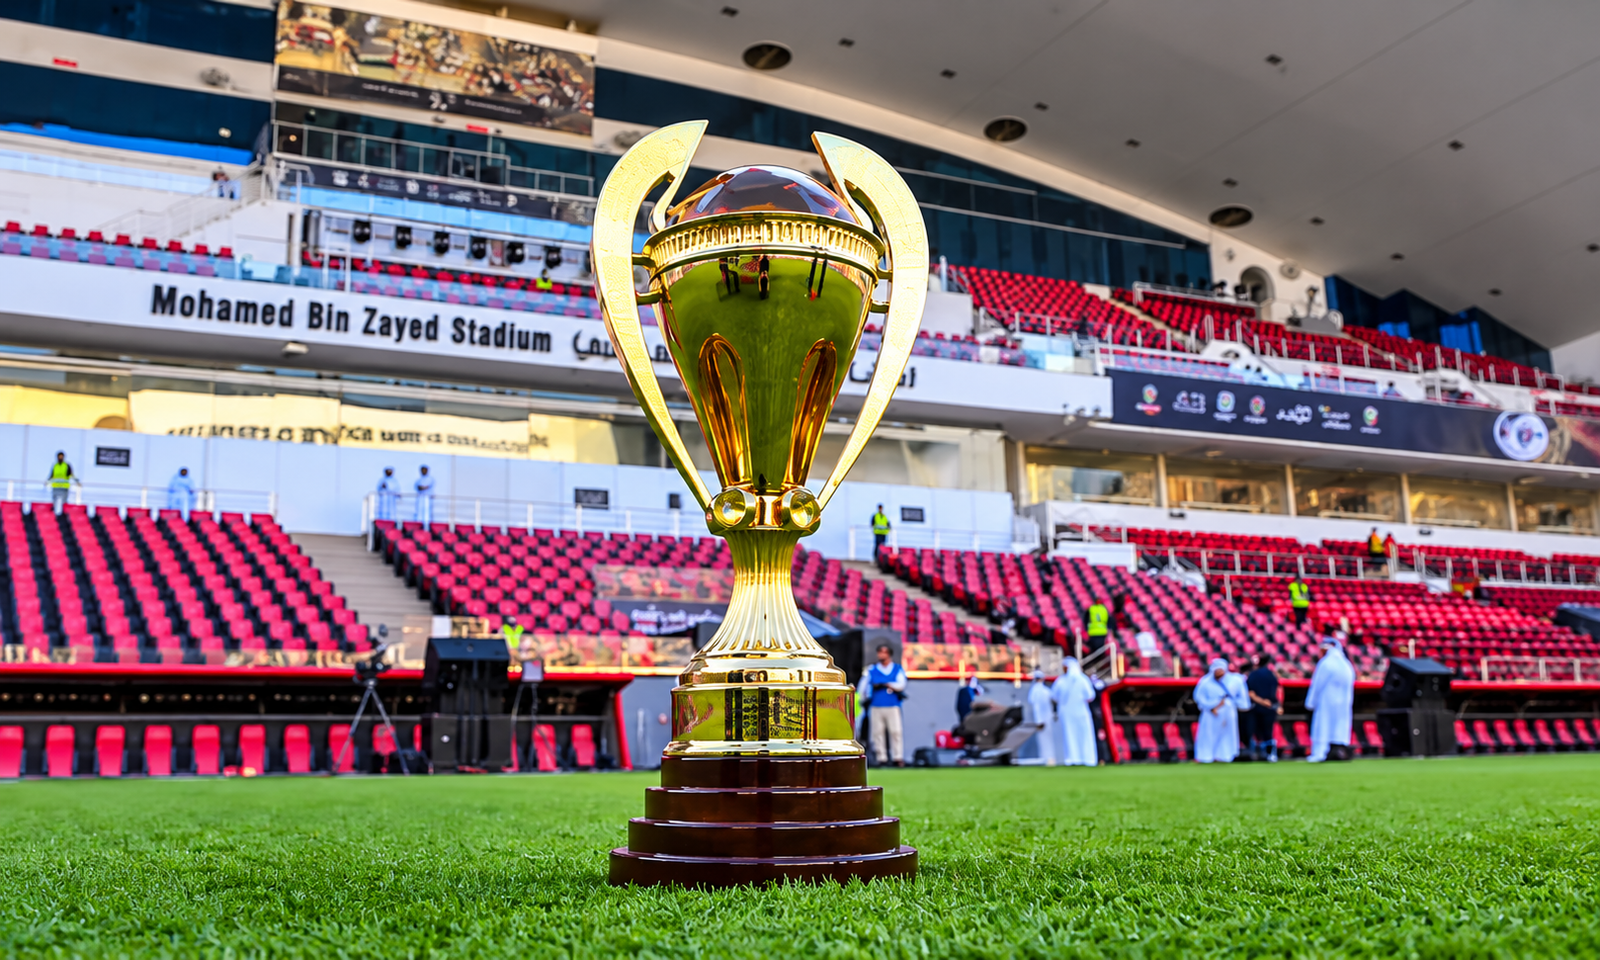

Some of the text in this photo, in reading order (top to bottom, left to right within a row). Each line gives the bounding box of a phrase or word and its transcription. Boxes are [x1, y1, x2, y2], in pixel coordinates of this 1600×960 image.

[151, 284, 293, 327] Mohamed
[307, 301, 350, 332] Bin
[362, 306, 439, 342] Zayed
[451, 316, 552, 352] Stadium
